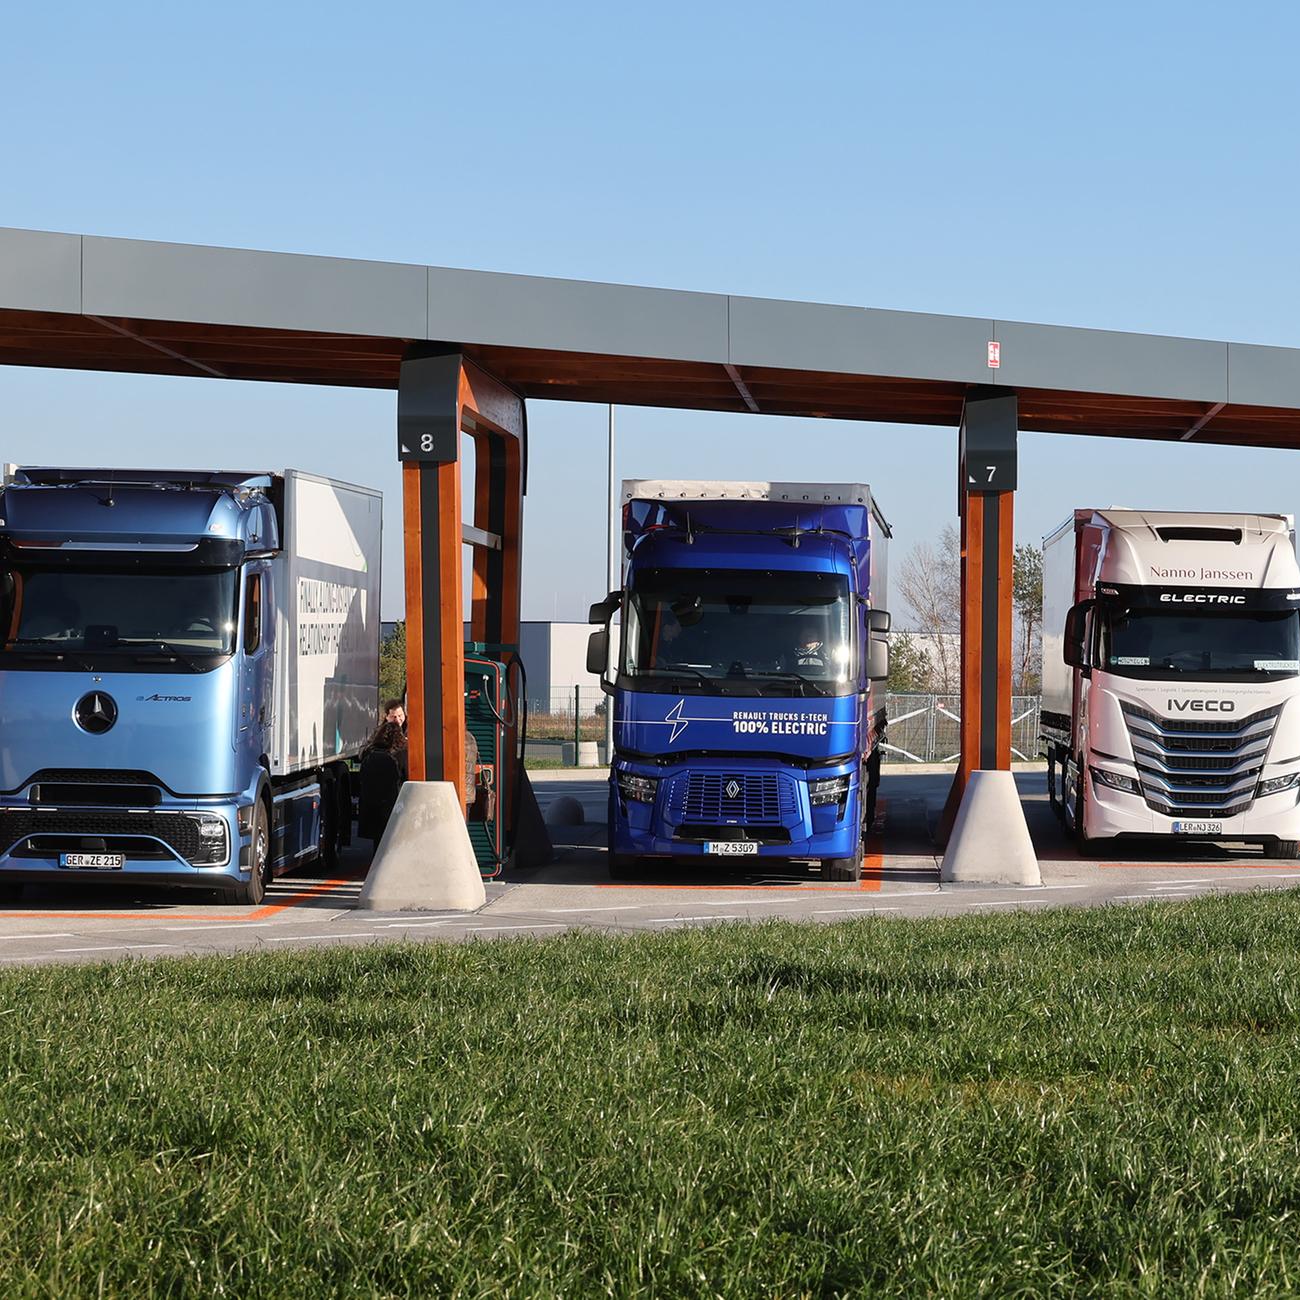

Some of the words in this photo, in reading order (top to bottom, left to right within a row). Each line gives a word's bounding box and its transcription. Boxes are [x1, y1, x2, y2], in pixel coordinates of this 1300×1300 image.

[420, 433, 434, 452] 8
[986, 466, 997, 482] 7
[1150, 566, 1196, 579] Nanno
[1200, 567, 1253, 580] Janssen
[1160, 594, 1246, 604] ELECTRIC
[1168, 699, 1235, 712] IVECO
[733, 712, 767, 720] RENAULT
[769, 712, 798, 721] TRUCKS
[801, 713, 828, 722] E-TECH
[733, 721, 769, 734] 100%
[771, 722, 828, 735] ELECTRIC
[1180, 823, 1193, 832] LER
[1207, 823, 1219, 832] 326
[712, 843, 719, 852] M
[724, 843, 730, 852] Z
[731, 843, 754, 853] 5309
[66, 855, 83, 865] GER
[90, 855, 102, 866] ZE
[103, 856, 121, 866] 215
